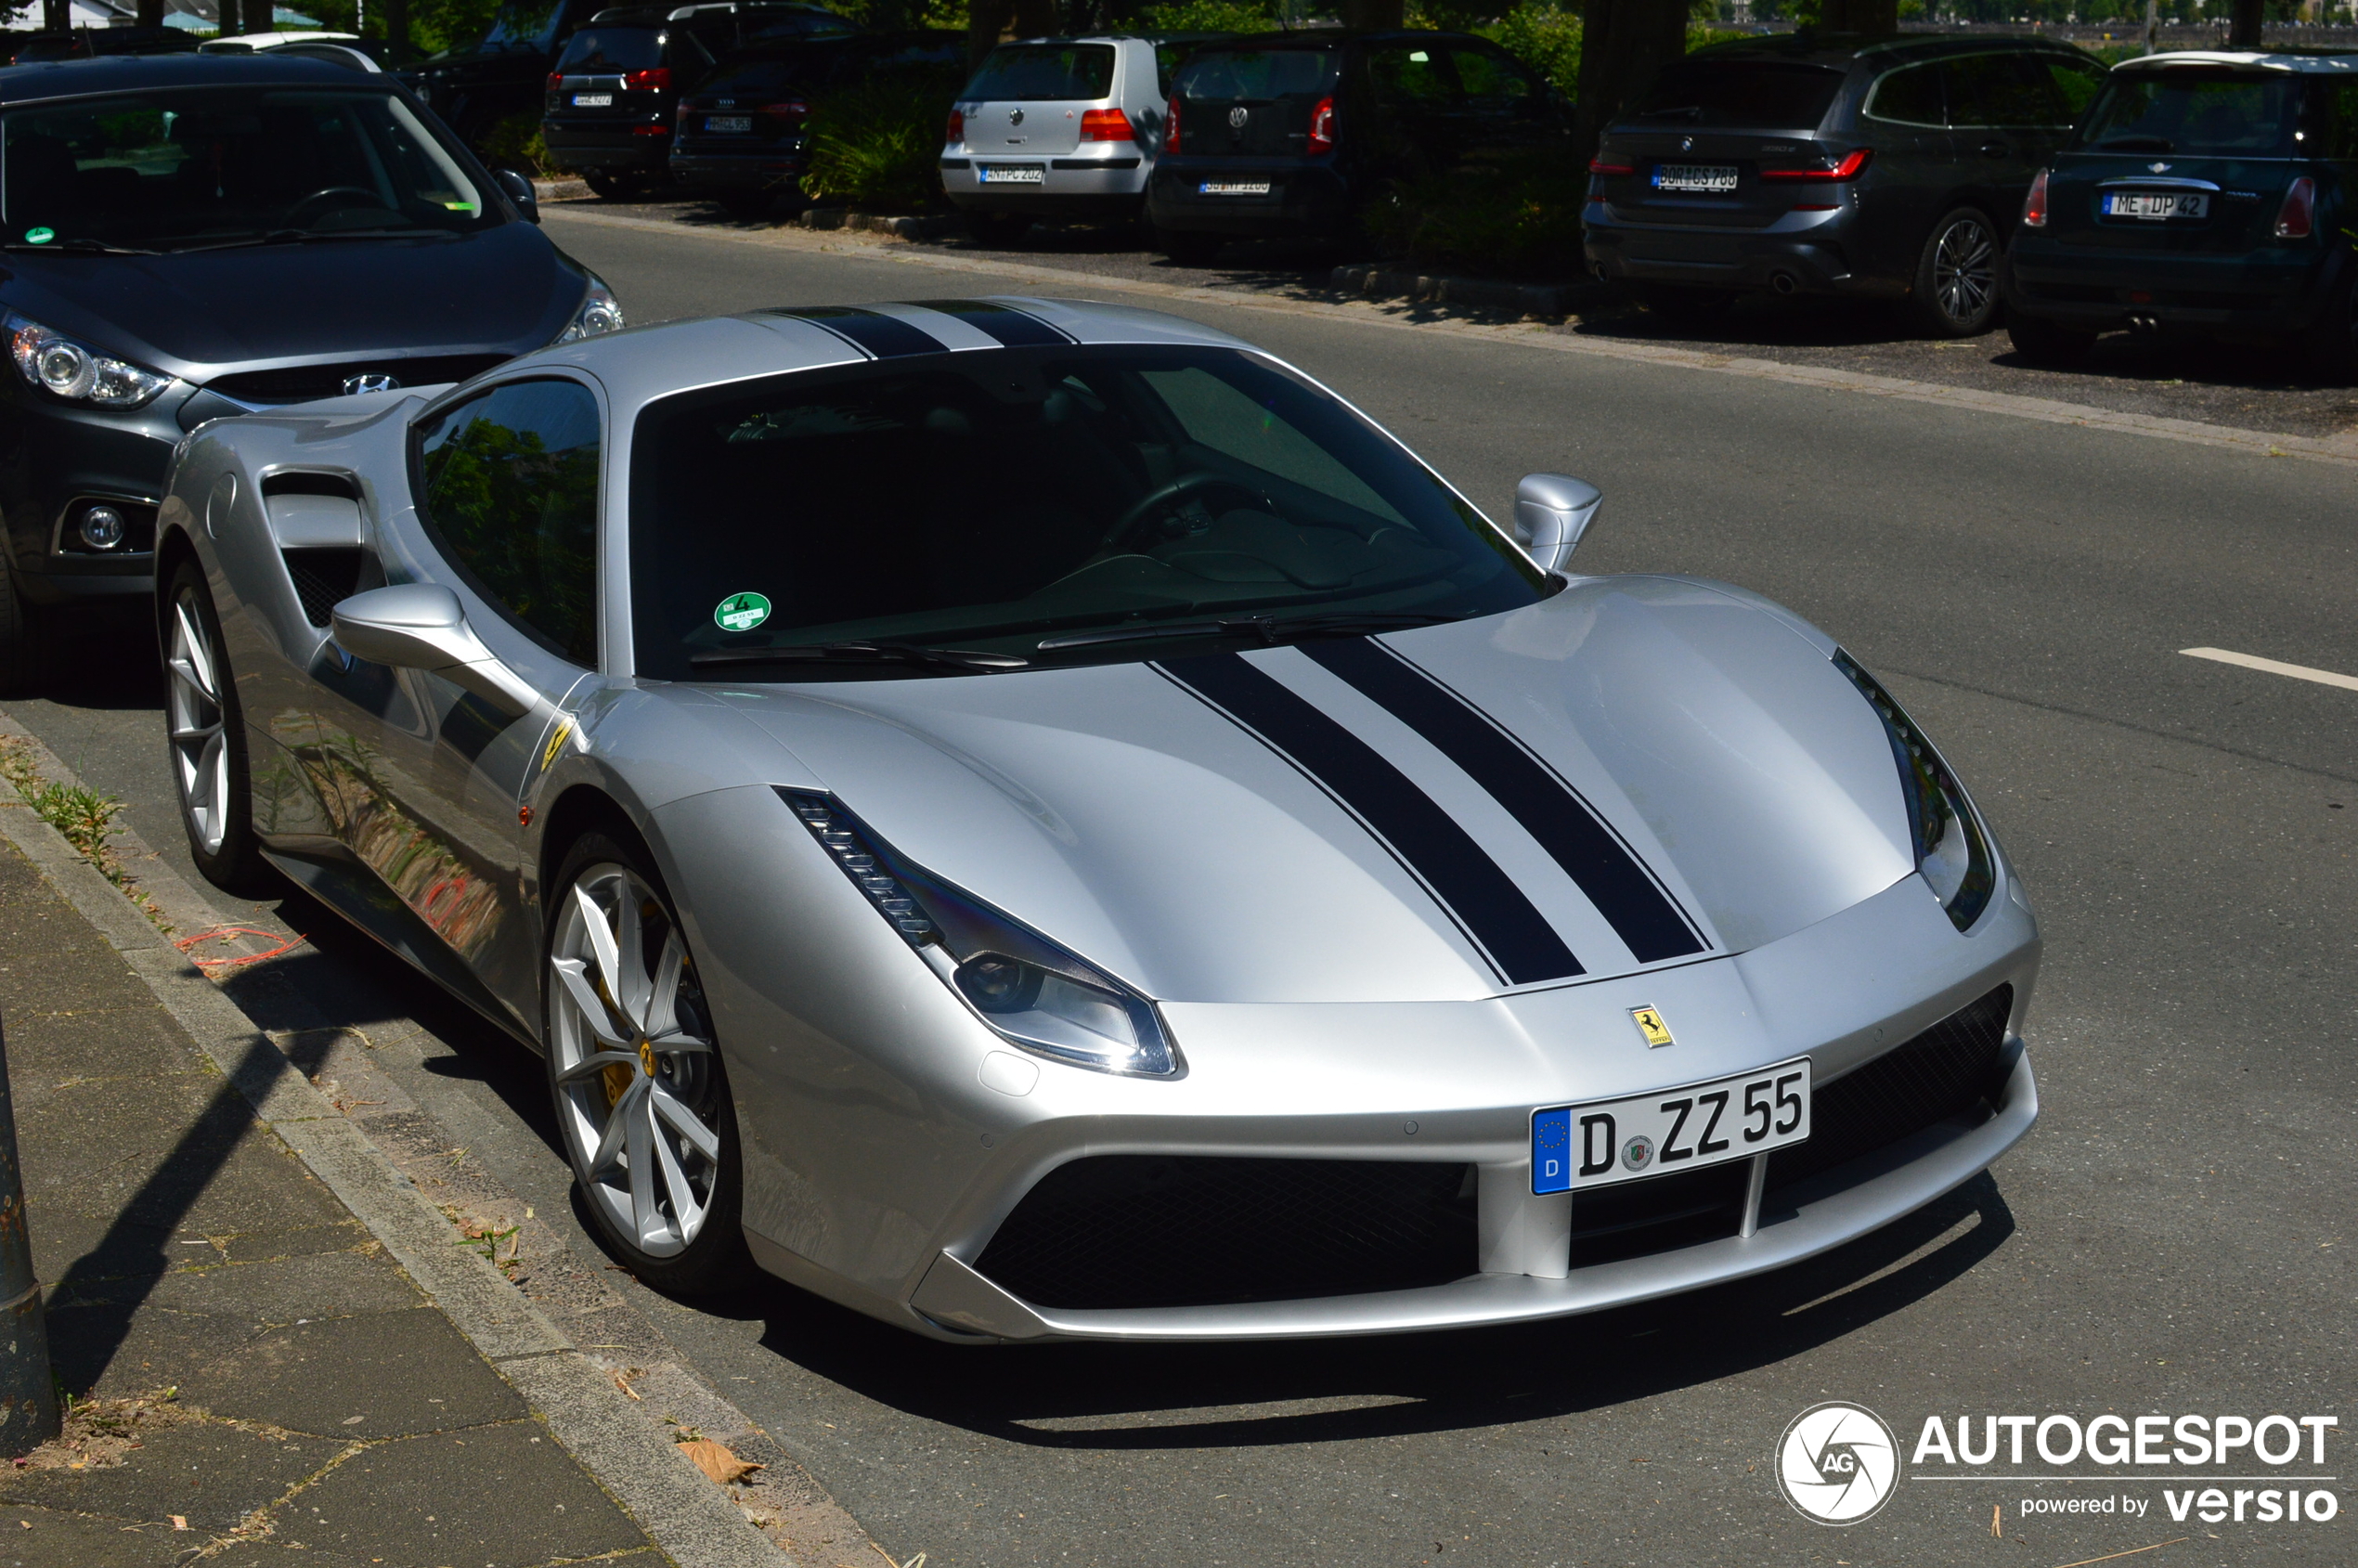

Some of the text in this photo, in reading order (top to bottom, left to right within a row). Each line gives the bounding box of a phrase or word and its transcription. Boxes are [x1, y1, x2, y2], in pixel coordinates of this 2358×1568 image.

[988, 166, 1041, 180] AN PC 202
[1660, 166, 1684, 185] BOR
[1712, 168, 1736, 187] 788
[2117, 194, 2140, 213] ME
[2150, 194, 2174, 214] DP
[2177, 195, 2200, 215] 42
[734, 594, 750, 611] 4
[1545, 1160, 1559, 1177] D
[1579, 1112, 1615, 1177] D
[1659, 1089, 1730, 1163] ZZ
[1743, 1070, 1803, 1143] 55
